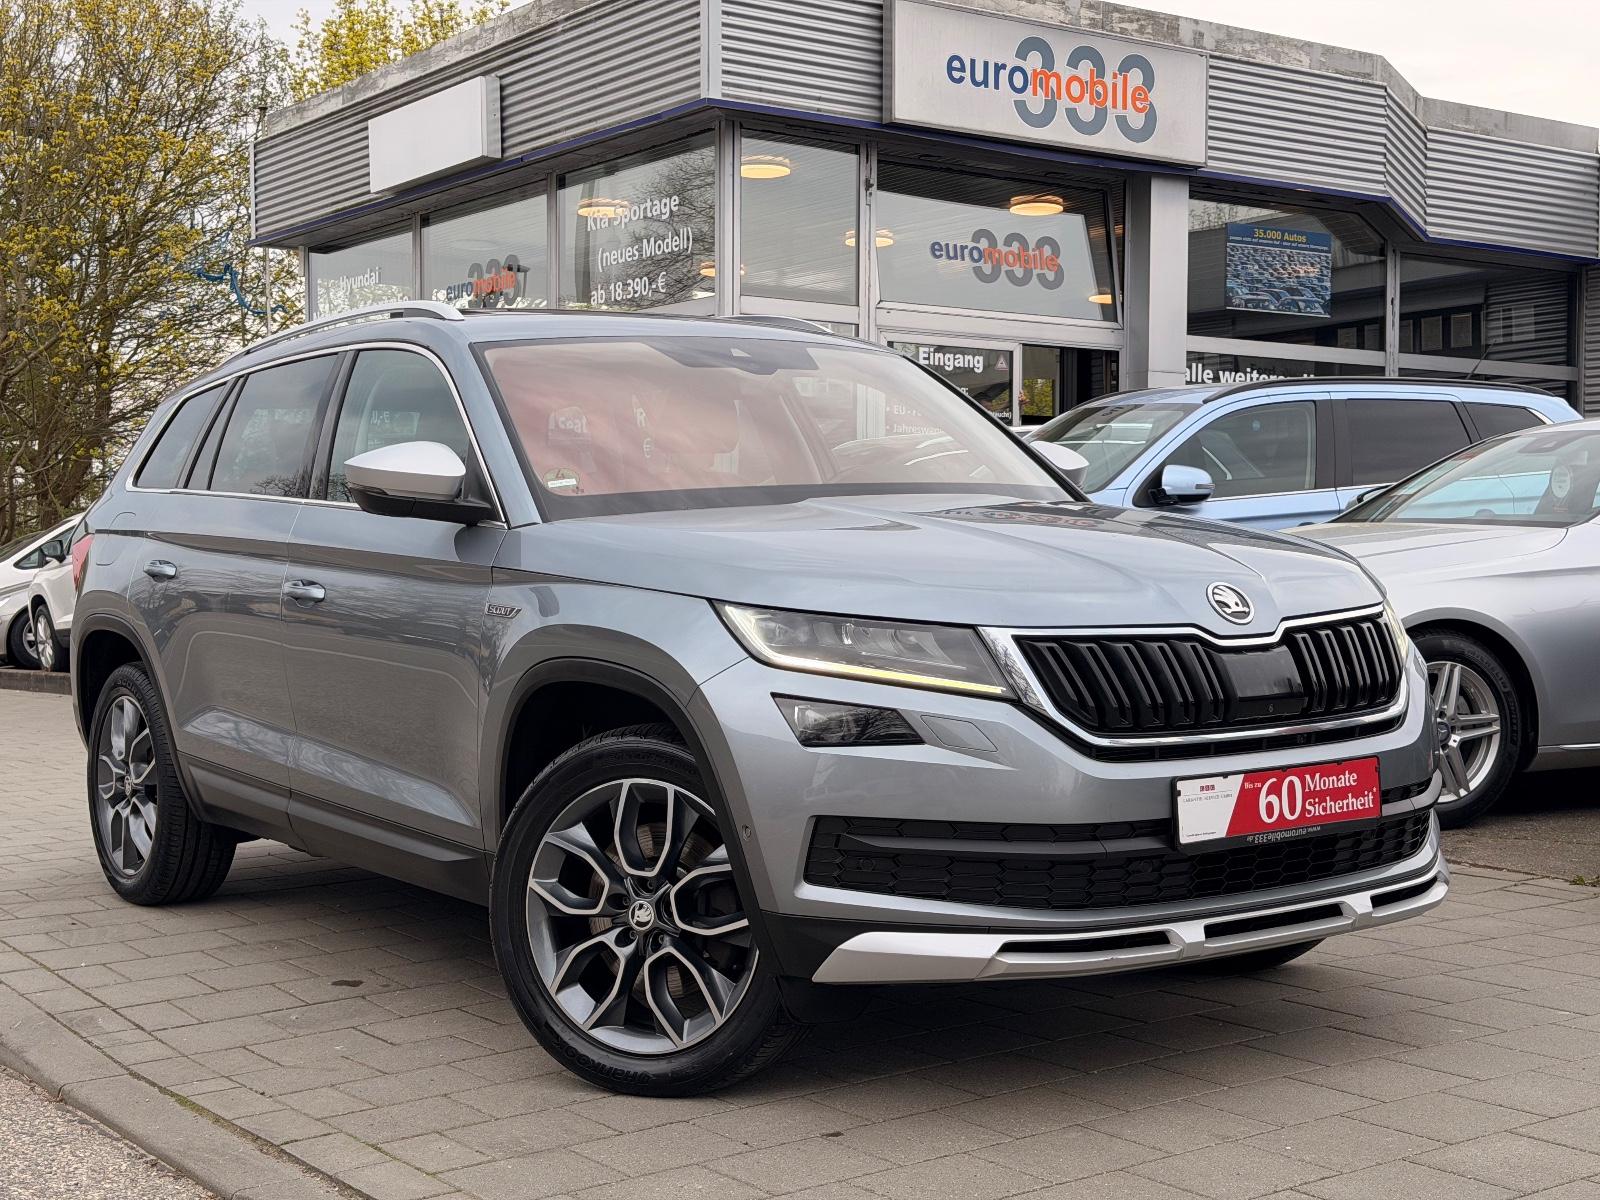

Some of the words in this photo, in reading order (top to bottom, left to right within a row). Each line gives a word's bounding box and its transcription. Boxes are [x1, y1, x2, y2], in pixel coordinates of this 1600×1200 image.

[946, 54, 1151, 114] euromobile
[1013, 36, 1158, 144] 333
[613, 195, 679, 229] Sportage
[598, 247, 640, 273] (neues
[642, 226, 693, 258] Modell)
[1253, 228, 1282, 240] 35.000
[1283, 232, 1307, 243] Autos
[929, 241, 1061, 273] euromobile
[340, 265, 380, 295] Hyundai
[590, 284, 606, 306] ab
[918, 346, 984, 373] Eingang
[489, 605, 511, 616] SCOUT
[1244, 782, 1254, 790] Bis
[1254, 781, 1262, 789] zu
[1304, 771, 1358, 792] Monate
[1258, 775, 1303, 824] 60
